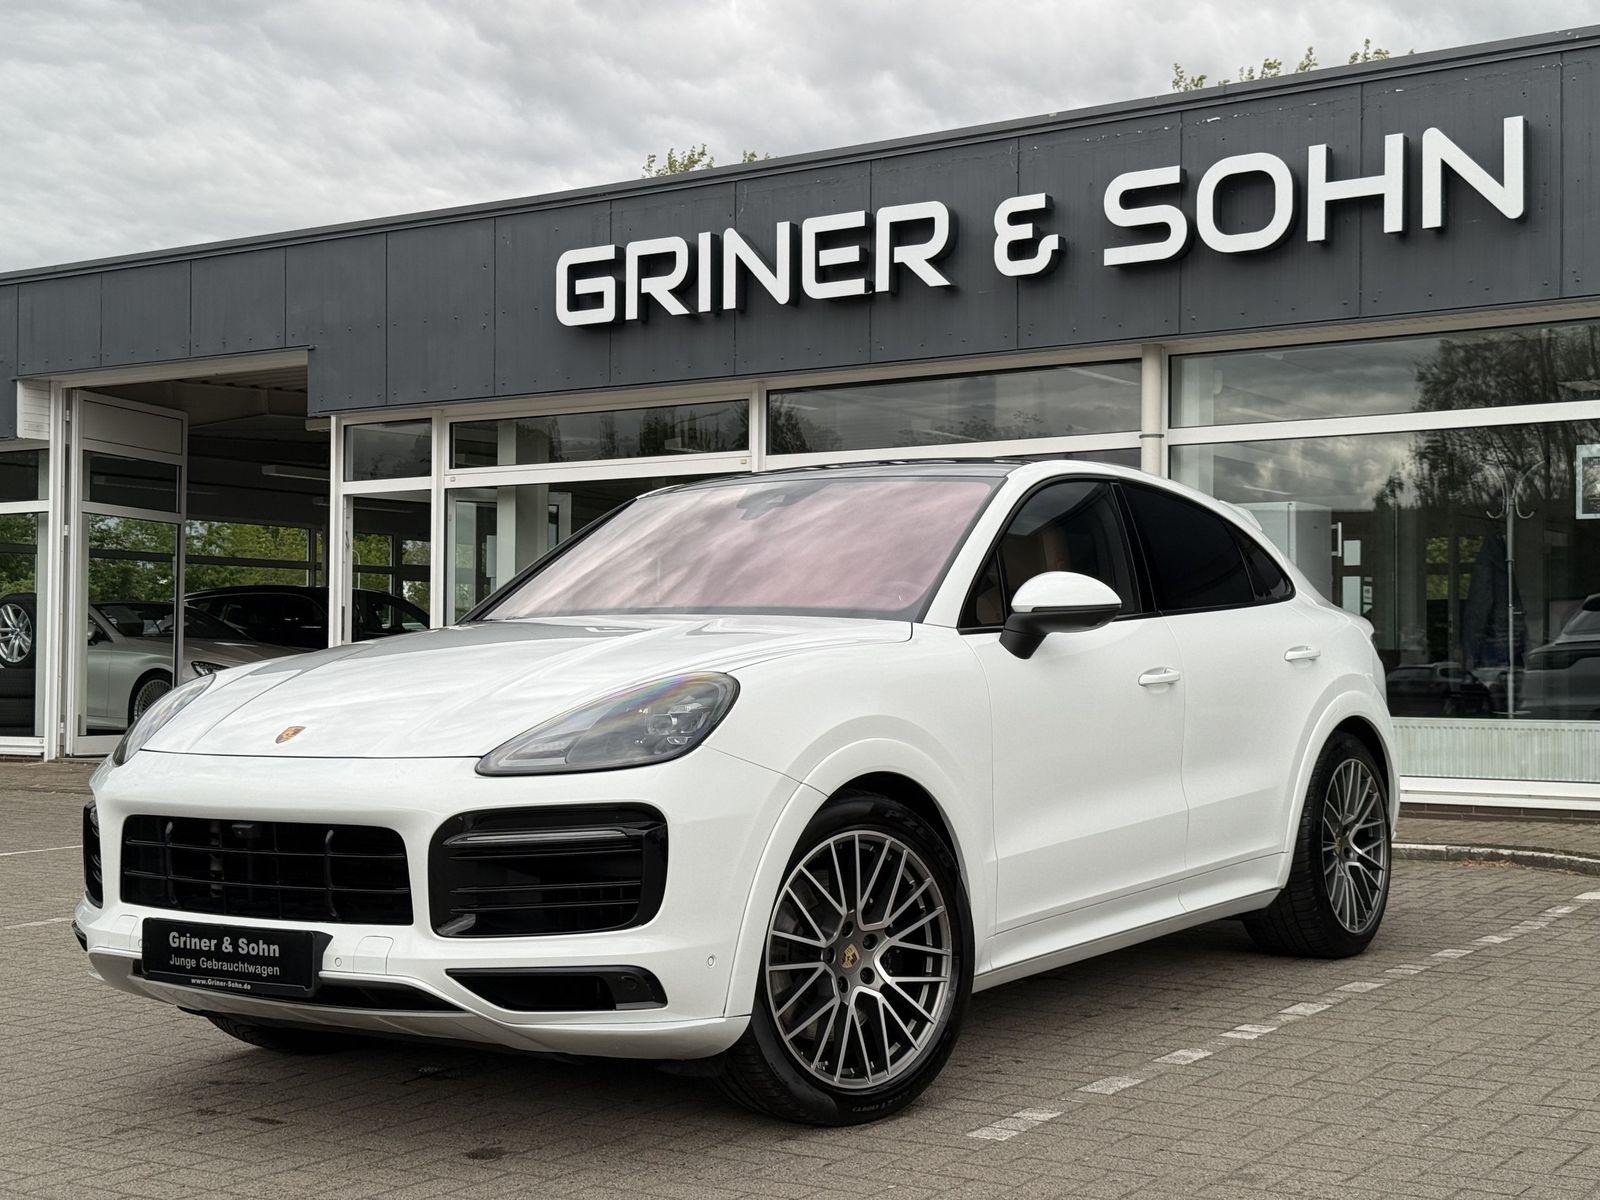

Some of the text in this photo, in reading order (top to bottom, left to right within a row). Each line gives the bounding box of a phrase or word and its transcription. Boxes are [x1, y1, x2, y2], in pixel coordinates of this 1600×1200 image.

[556, 115, 1526, 327] GRINER & SOHN
[168, 931, 280, 957] Griner & Sohn
[169, 954, 280, 977] Junge Gebrauchtwagen
[190, 977, 251, 990] www.Griner-Sohn.de
